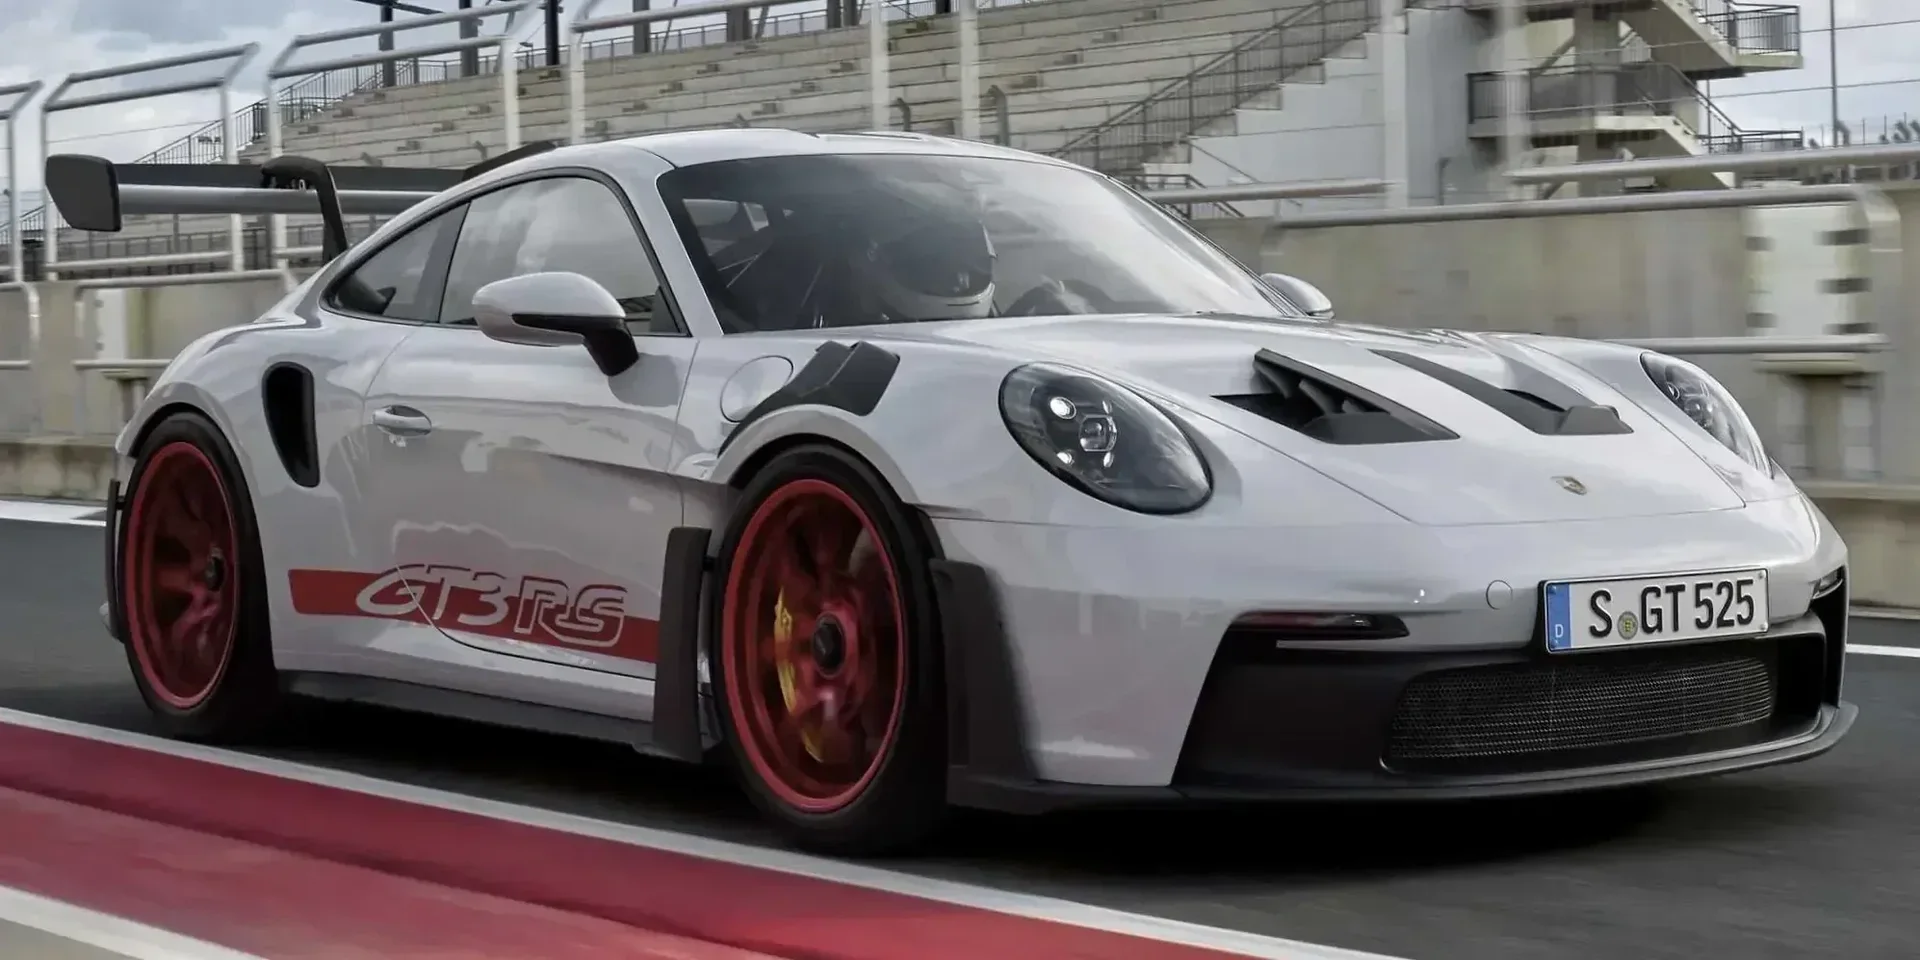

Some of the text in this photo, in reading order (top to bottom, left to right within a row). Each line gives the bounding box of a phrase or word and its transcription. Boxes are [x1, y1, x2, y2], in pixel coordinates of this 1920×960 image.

[1589, 579, 1755, 638] S GT 525
[1555, 623, 1564, 639] D
